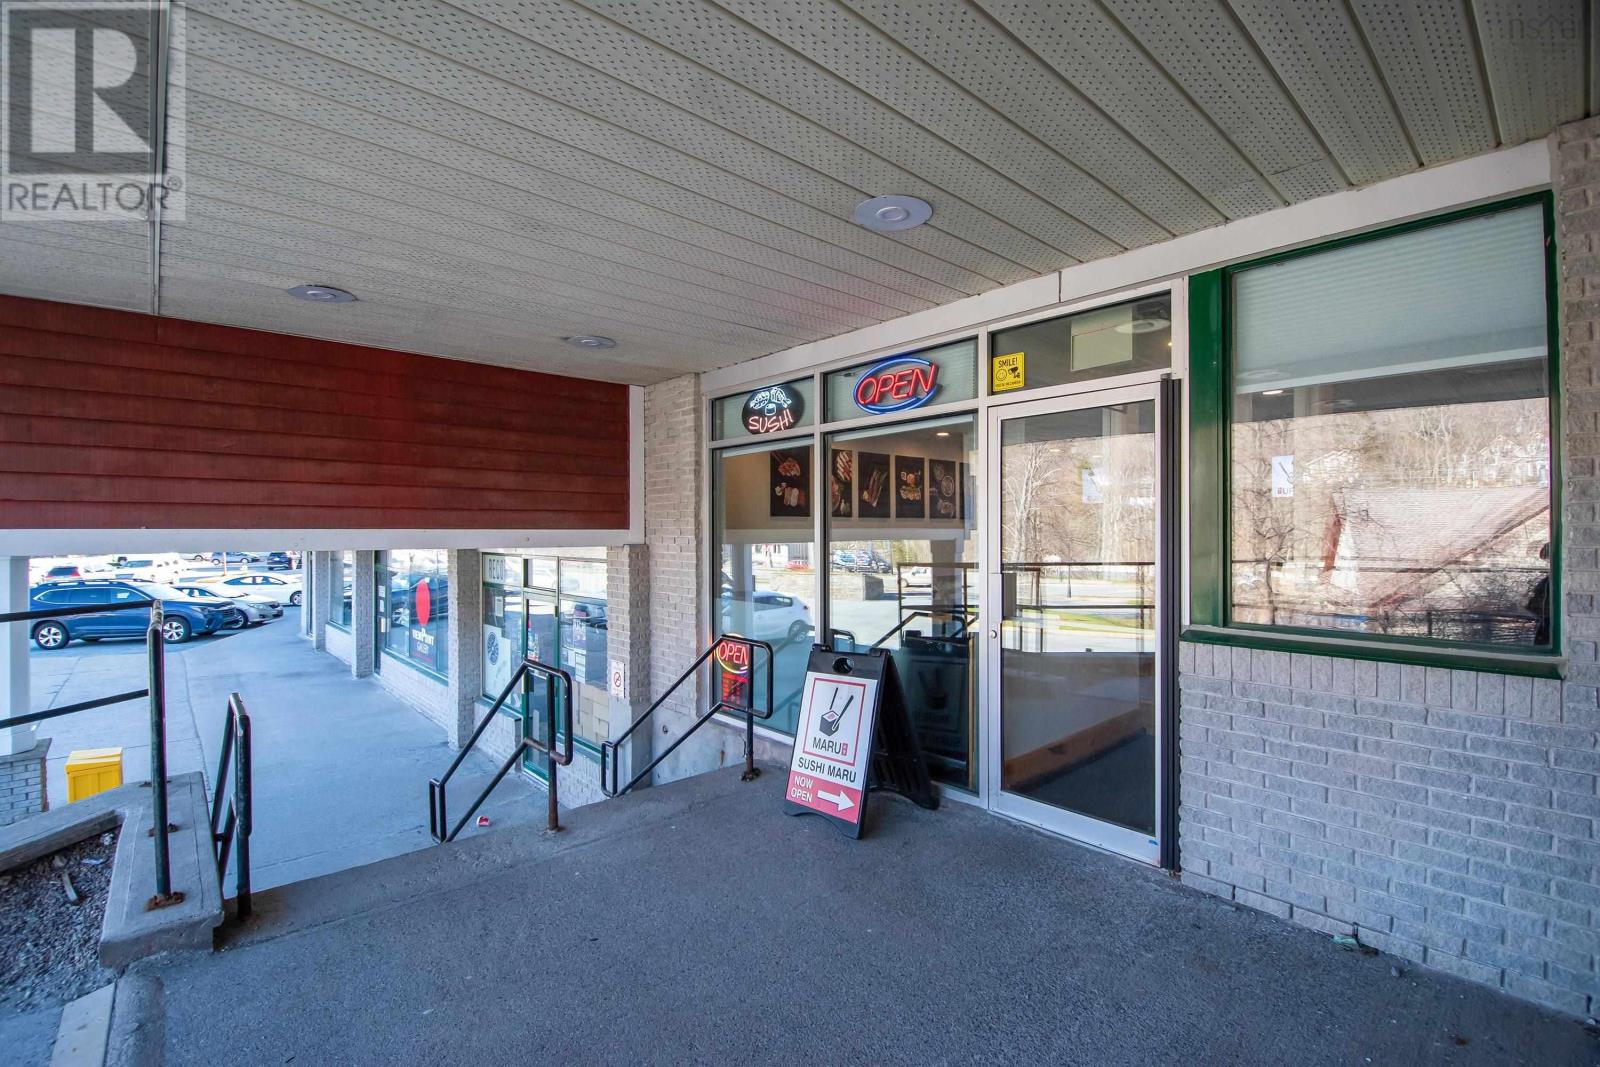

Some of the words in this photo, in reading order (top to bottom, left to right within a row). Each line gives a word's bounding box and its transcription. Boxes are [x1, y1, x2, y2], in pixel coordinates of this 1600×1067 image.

[998, 357, 1018, 368] SMILE!
[857, 363, 937, 404] OPEN
[748, 408, 794, 433] SUSHI
[719, 642, 748, 665] OPEN
[813, 737, 841, 754] MARU
[798, 757, 826, 774] SUSHI
[827, 765, 857, 783] MARU
[794, 775, 813, 789] NOW
[791, 787, 813, 802] OPEN
